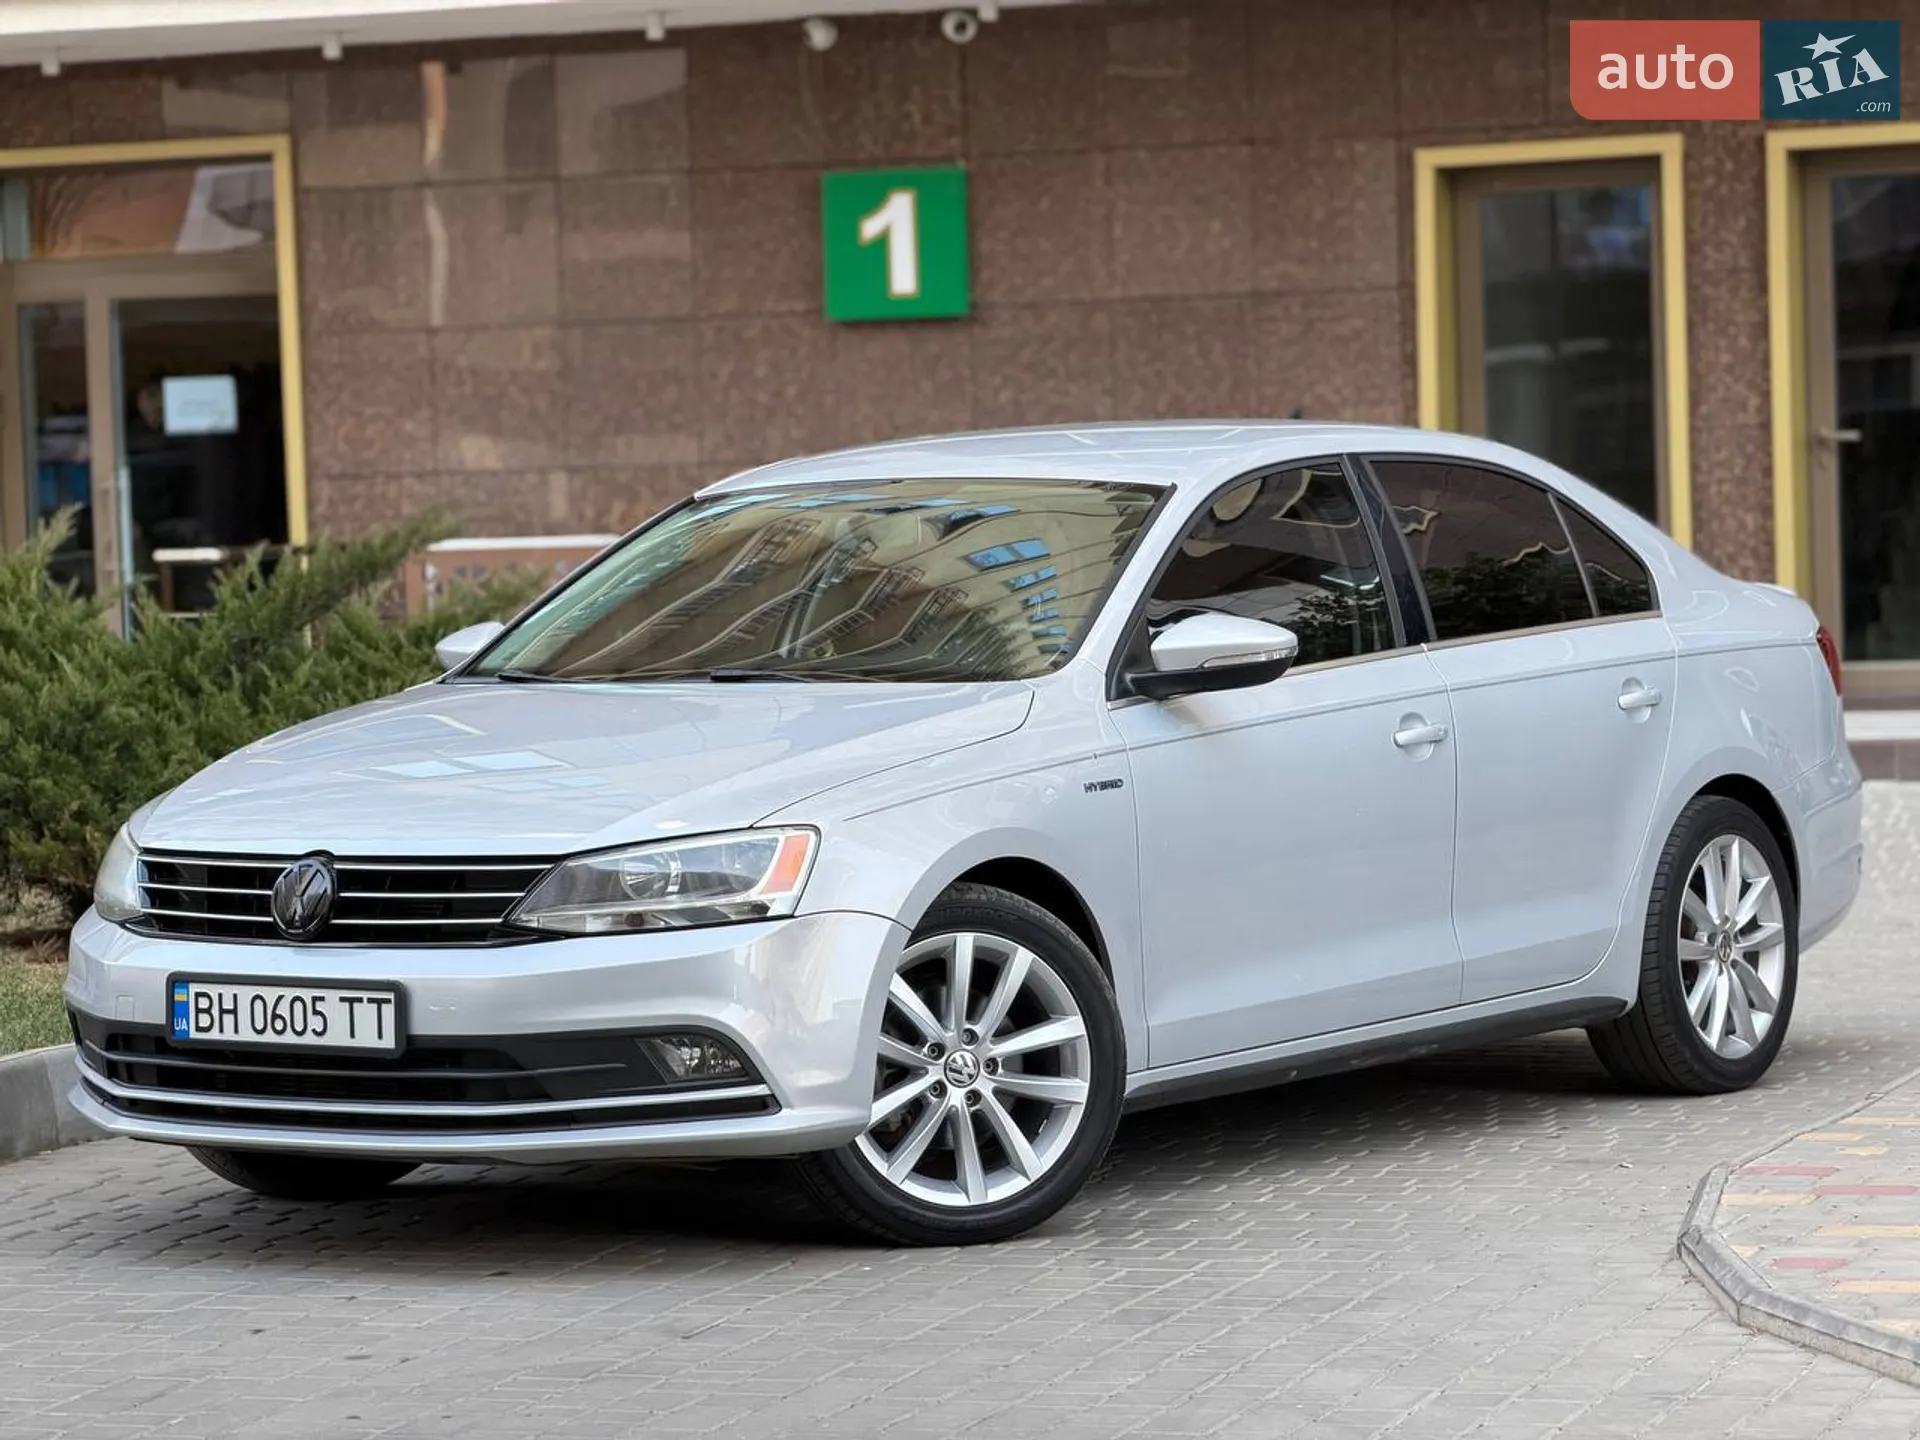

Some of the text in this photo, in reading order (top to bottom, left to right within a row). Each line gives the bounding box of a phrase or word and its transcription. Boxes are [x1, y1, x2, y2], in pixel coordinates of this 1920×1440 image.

[858, 188, 920, 299] 1
[1083, 779, 1124, 793] HYBRID
[174, 1017, 188, 1031] UA
[194, 991, 392, 1040] BH 0605 TT
